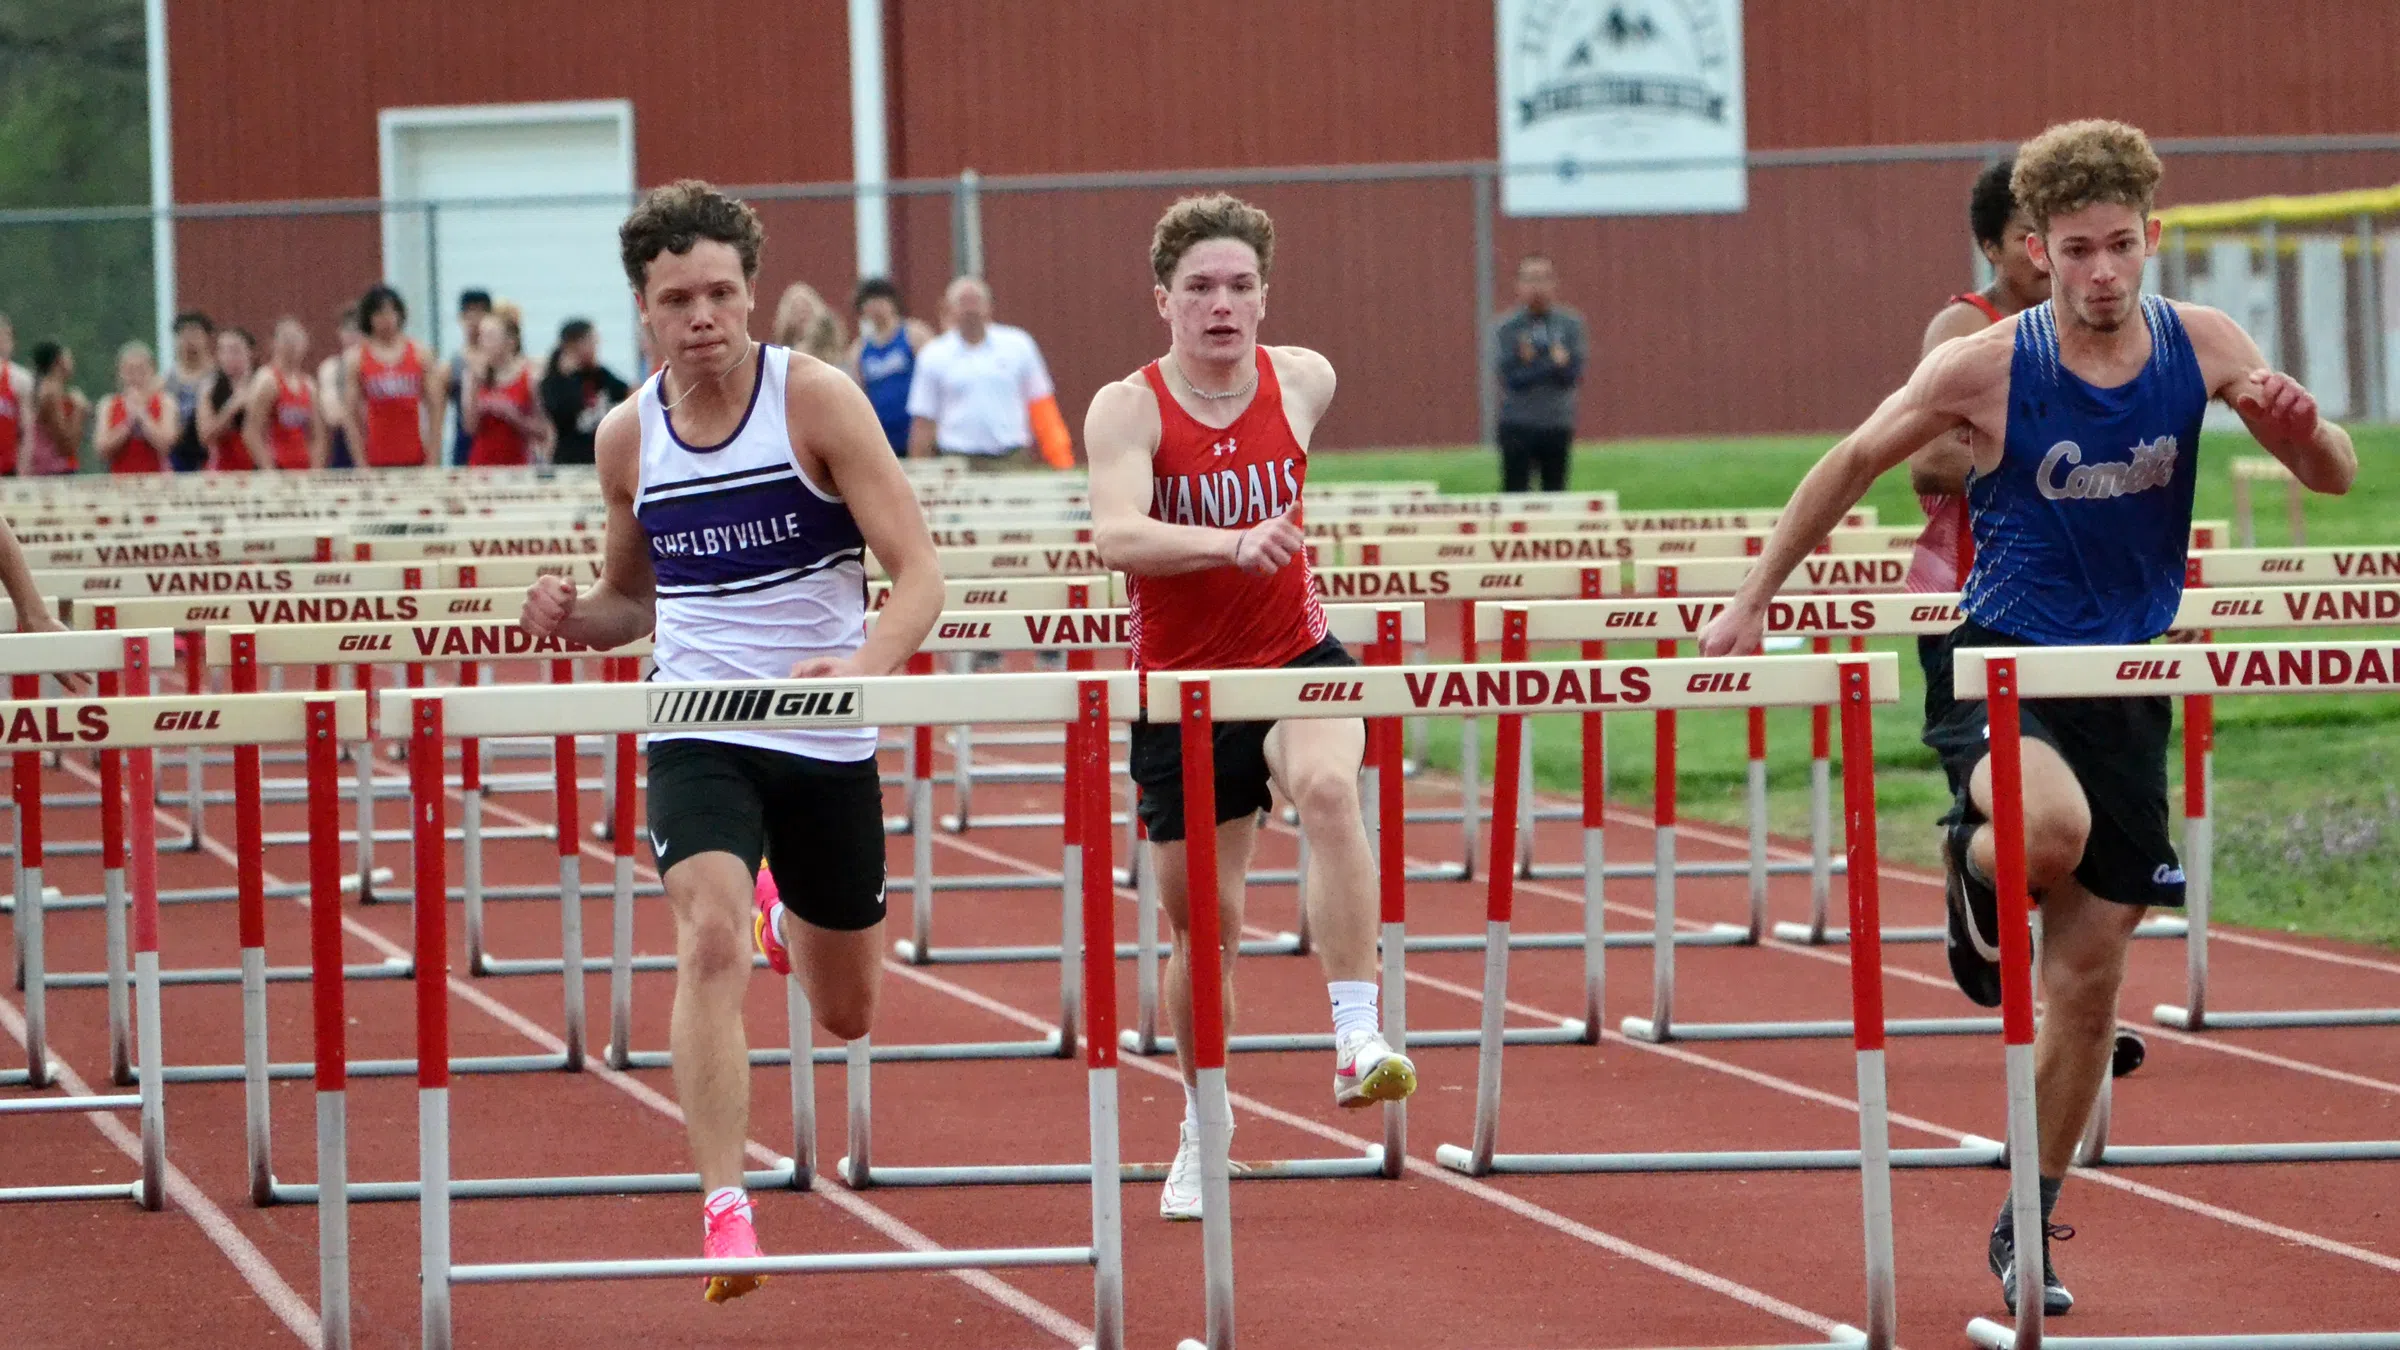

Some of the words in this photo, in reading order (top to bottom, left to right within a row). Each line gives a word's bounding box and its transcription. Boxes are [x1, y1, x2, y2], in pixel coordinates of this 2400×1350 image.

[1154, 458, 1298, 528] VANDALS
[469, 536, 598, 557] VANDALS
[653, 512, 800, 556] SHELBYVILLE
[96, 540, 221, 564] VANDALS
[1490, 537, 1634, 562] VANDALS
[1805, 560, 1904, 585] VAND
[2261, 558, 2305, 573] GILL
[146, 569, 293, 593] VANDALS
[1314, 570, 1450, 597] ANDALS
[1479, 574, 1524, 588] GILL
[186, 605, 231, 621] GILL
[248, 595, 418, 624] VANDALS
[448, 598, 492, 613] GILL
[964, 590, 1008, 605] GILL
[2211, 599, 2264, 617] GILL
[938, 622, 991, 639] GILL
[1024, 614, 1132, 644] VAND
[1605, 611, 1658, 628] GILL
[1677, 600, 1876, 633] VDALS
[1911, 605, 1963, 621] GILL
[338, 634, 392, 651] GILL
[2116, 660, 2181, 681] GILL
[2205, 647, 2400, 687] VANDA
[1298, 681, 1364, 702] GILL
[1404, 666, 1652, 709] VANDALS
[1686, 672, 1752, 693] GILL
[774, 688, 856, 718] GILL
[154, 710, 221, 732] GILL
